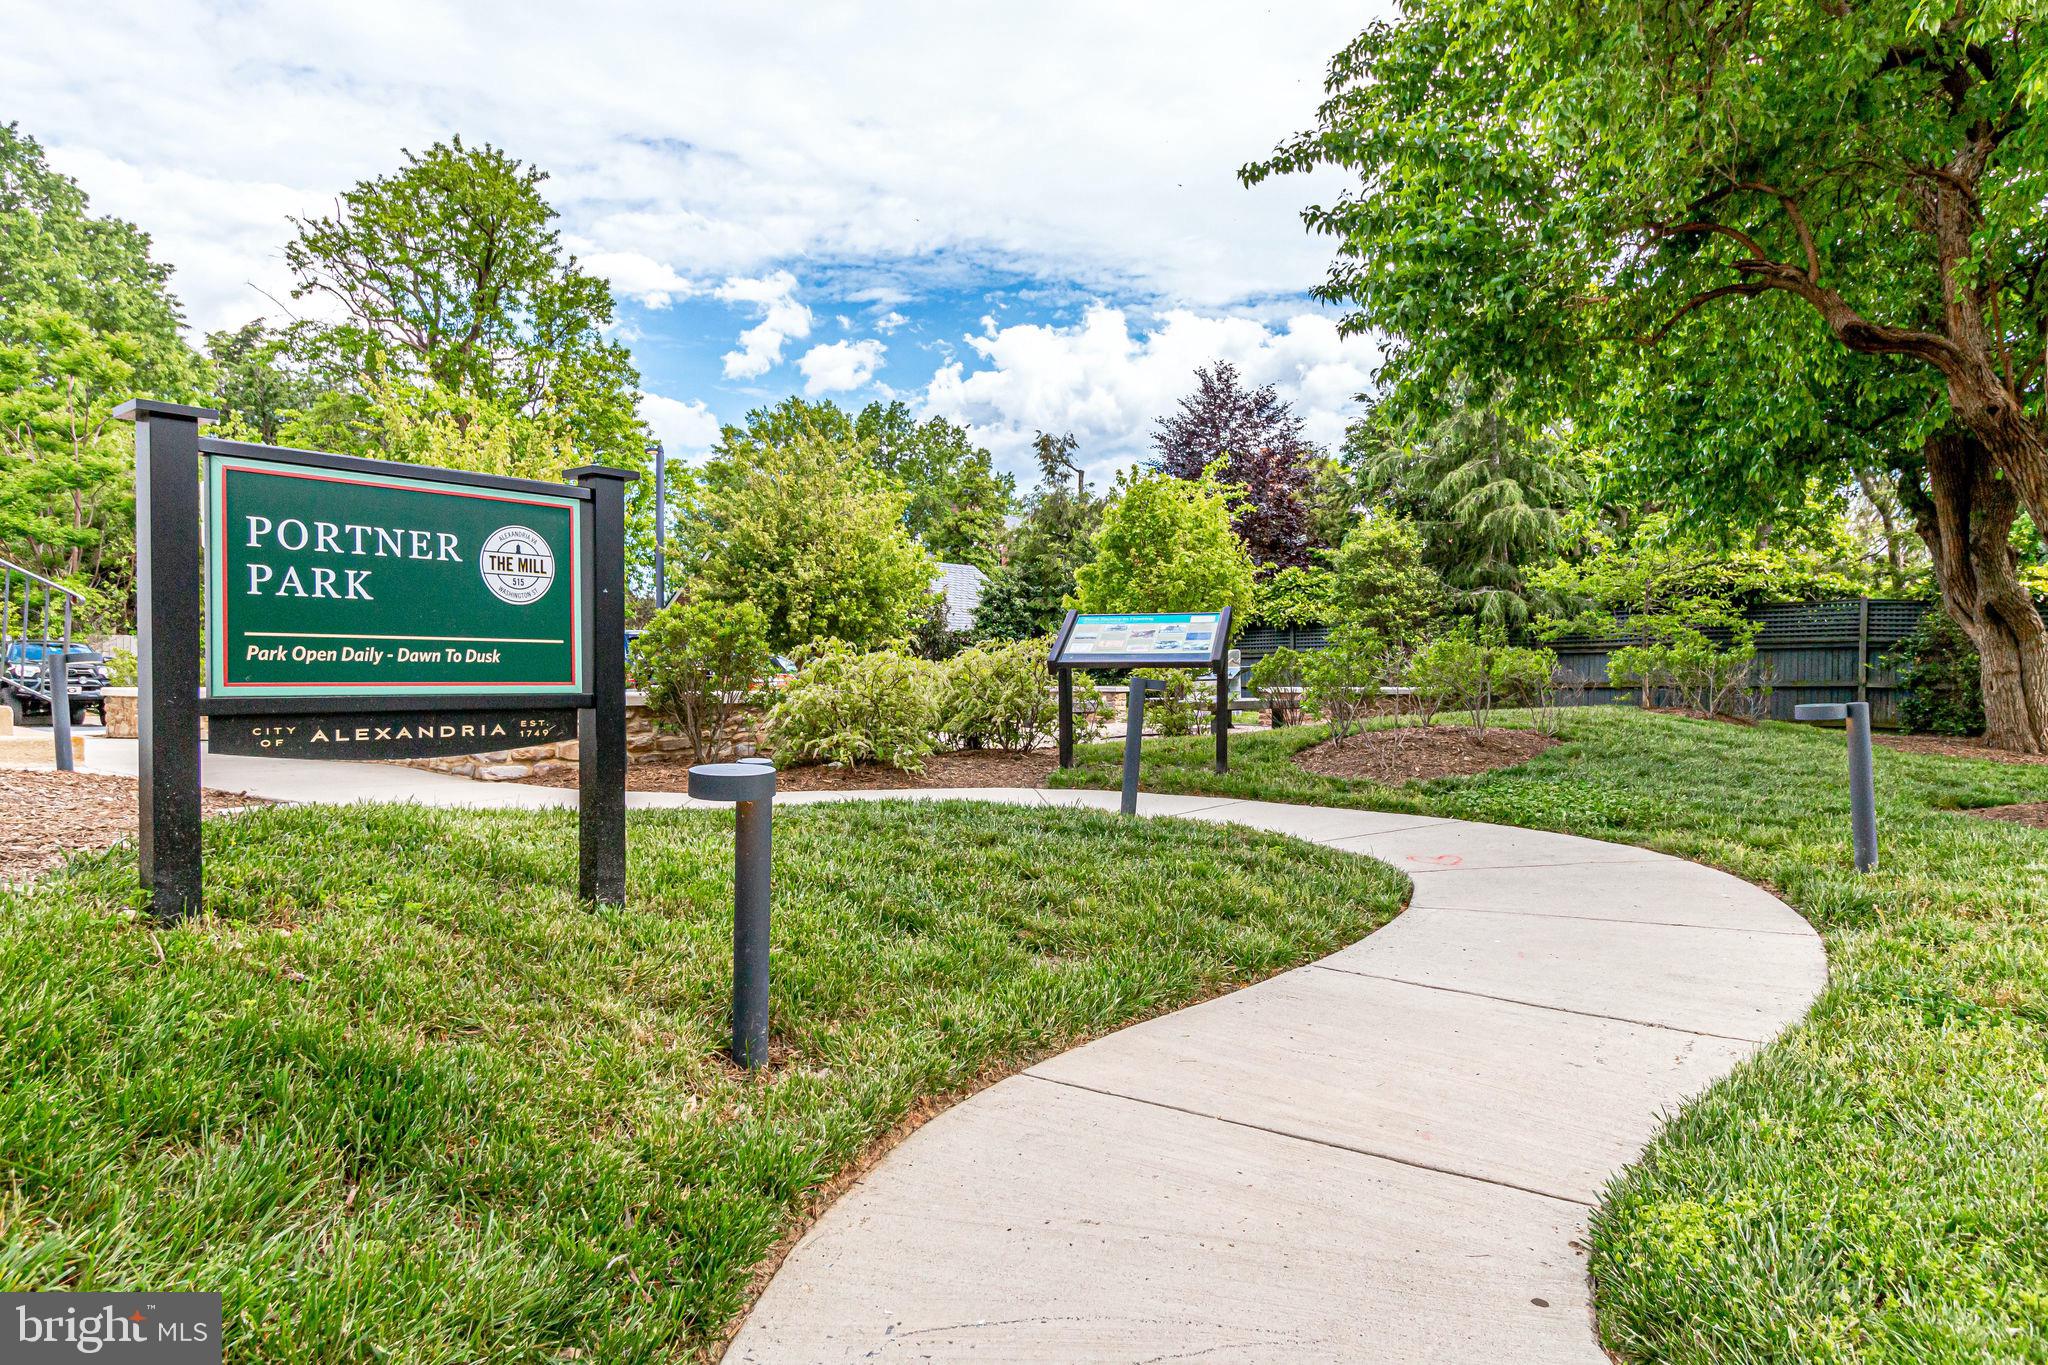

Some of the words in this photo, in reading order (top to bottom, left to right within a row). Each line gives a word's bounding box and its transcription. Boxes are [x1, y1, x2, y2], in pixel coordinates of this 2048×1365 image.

[245, 515, 464, 563] PORTNER
[489, 555, 514, 572] THE
[518, 557, 547, 574] MILL
[246, 563, 374, 600] PARK
[512, 577, 525, 586] 515
[498, 586, 532, 598] WASHINGTON
[246, 645, 287, 661] Park
[291, 646, 337, 664] Open
[341, 647, 384, 665] Daily
[397, 648, 441, 662] Dawn
[445, 649, 462, 663] To
[465, 649, 501, 663] Dusk
[520, 719, 549, 728] EST.
[252, 726, 297, 737] CITY
[310, 723, 507, 743] ALEXANDRIA
[520, 729, 549, 738] 1749
[260, 739, 284, 748] OF
